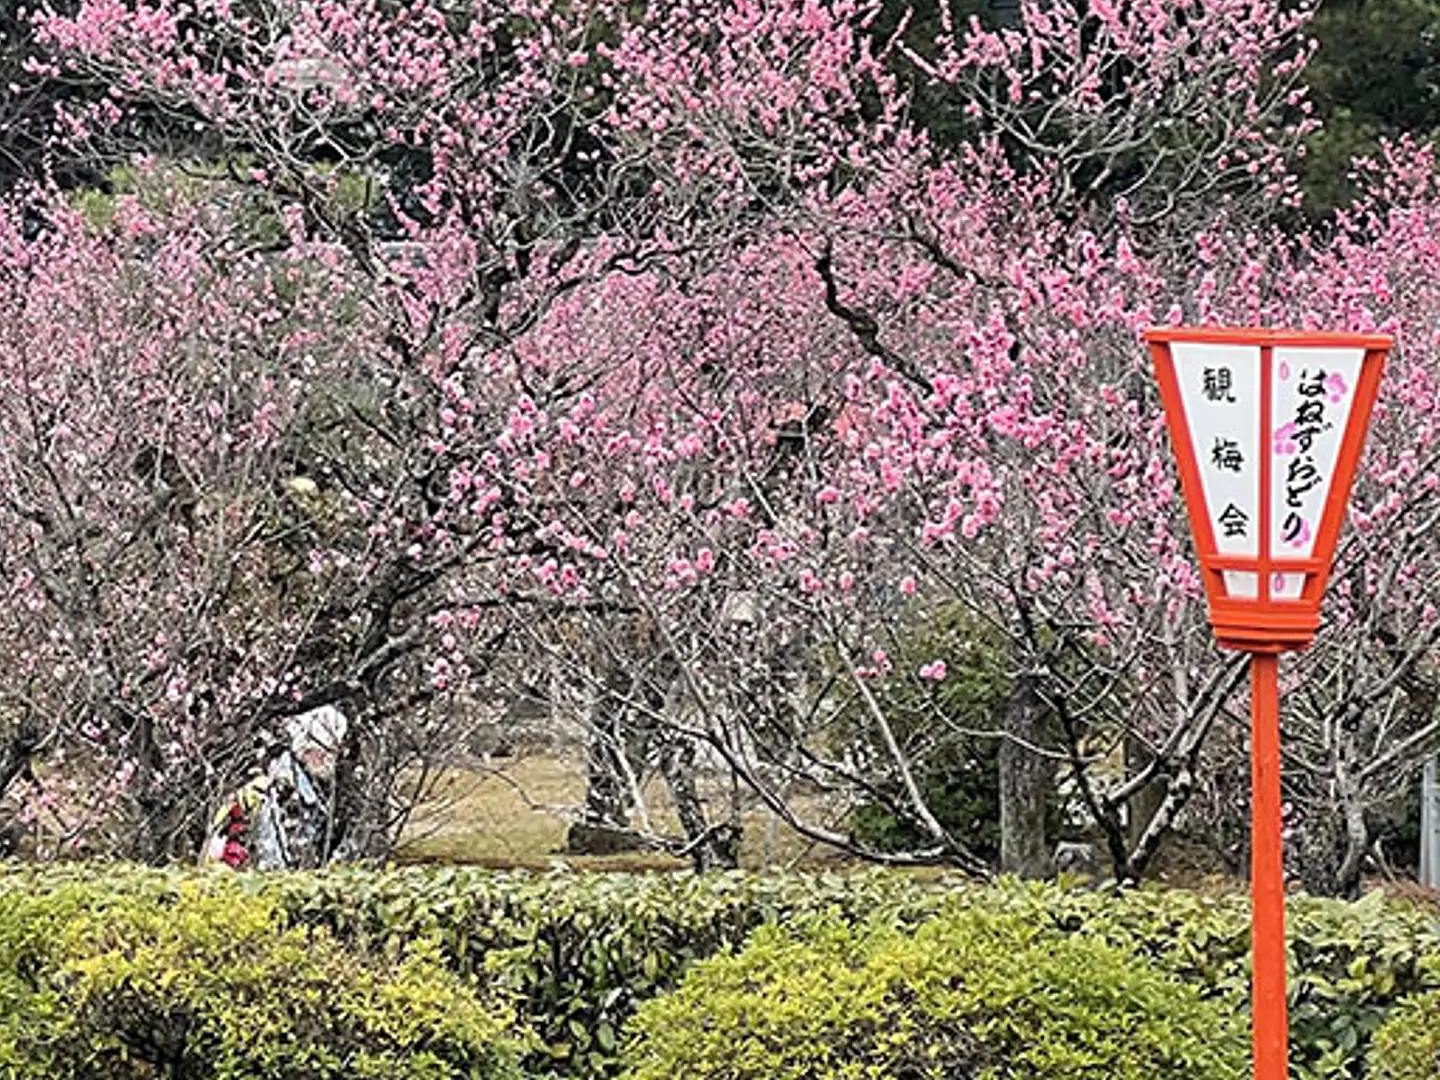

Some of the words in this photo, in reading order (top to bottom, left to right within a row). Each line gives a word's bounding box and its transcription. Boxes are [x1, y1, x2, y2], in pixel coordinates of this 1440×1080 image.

[1202, 366, 1250, 537] 観梅会
[1283, 369, 1334, 542] はねずおどり
